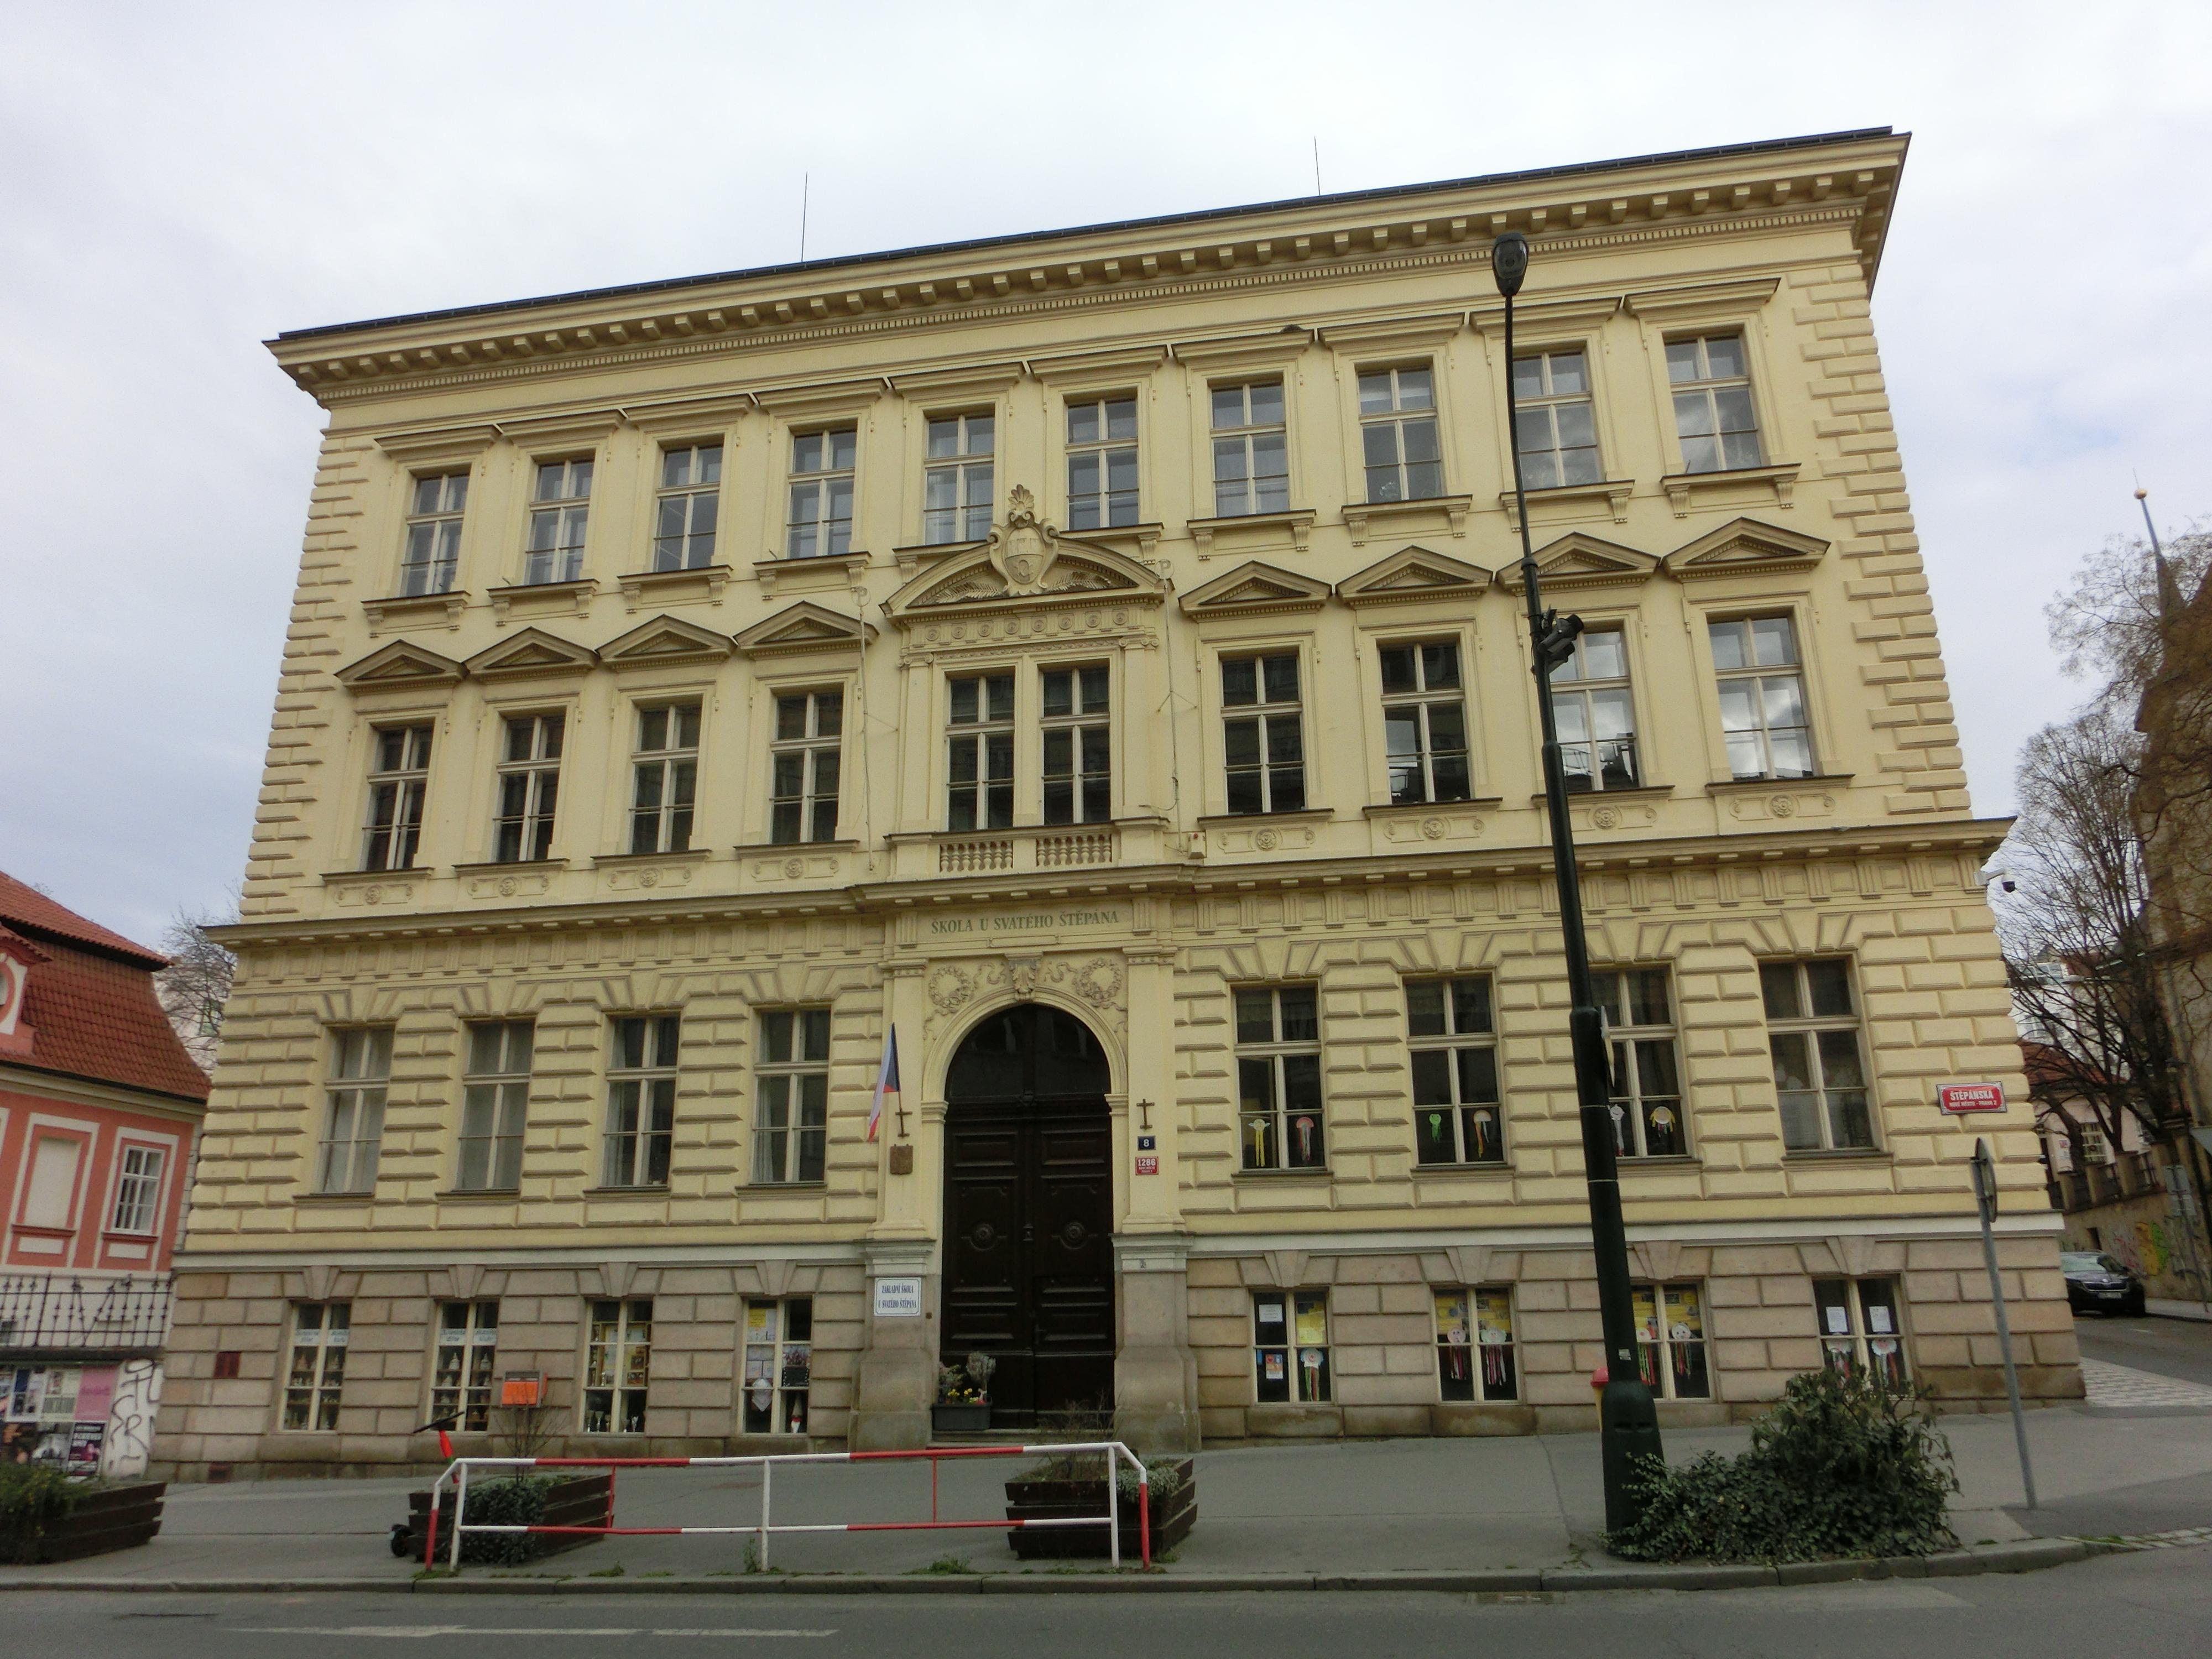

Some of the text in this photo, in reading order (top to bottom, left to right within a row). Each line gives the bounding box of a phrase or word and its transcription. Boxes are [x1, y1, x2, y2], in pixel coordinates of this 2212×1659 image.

[931, 908, 1119, 934] ŠKOLA U SVATÉHO ŠTĚPÁNA
[1143, 1139, 1150, 1147] 8
[1138, 1158, 1156, 1166] 1286
[901, 1283, 914, 1293] ŠKOLA
